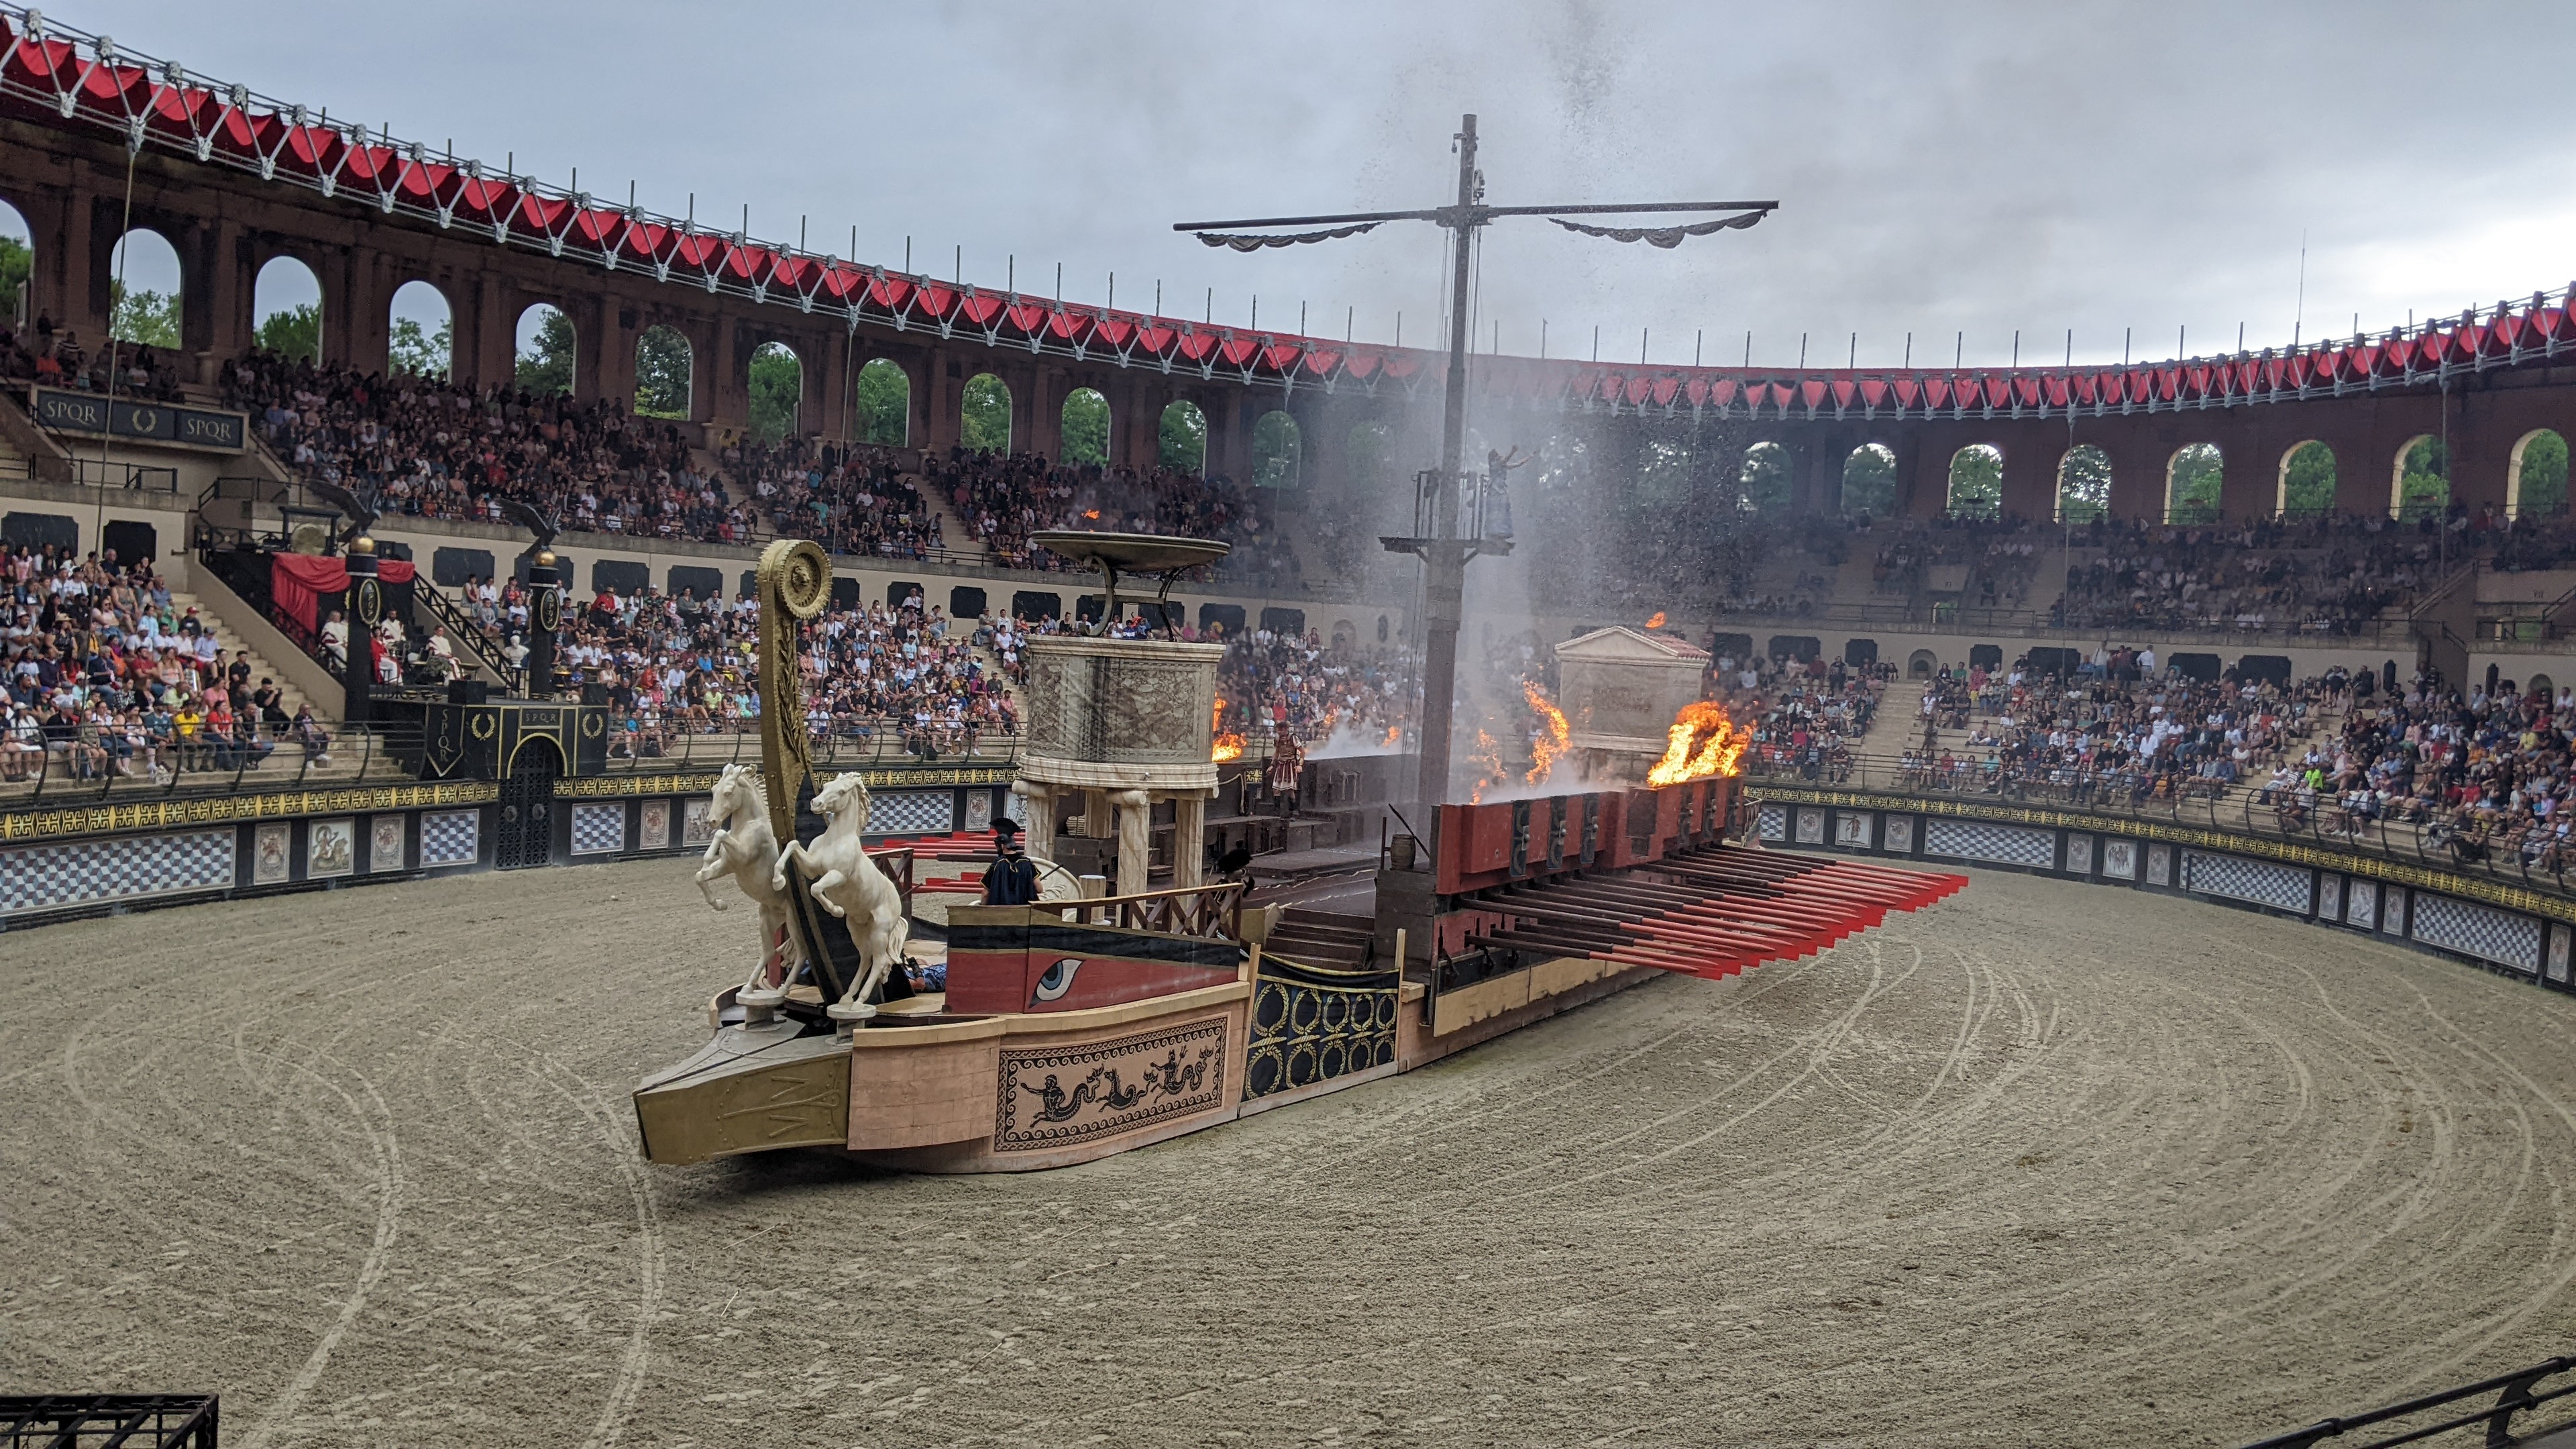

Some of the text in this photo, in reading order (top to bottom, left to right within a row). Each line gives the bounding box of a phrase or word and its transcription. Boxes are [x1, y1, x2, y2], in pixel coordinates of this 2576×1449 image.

[46, 400, 97, 426] SPQR
[186, 418, 231, 442] SPQR
[525, 713, 557, 723] SPQR
[438, 708, 454, 762] SPQR
